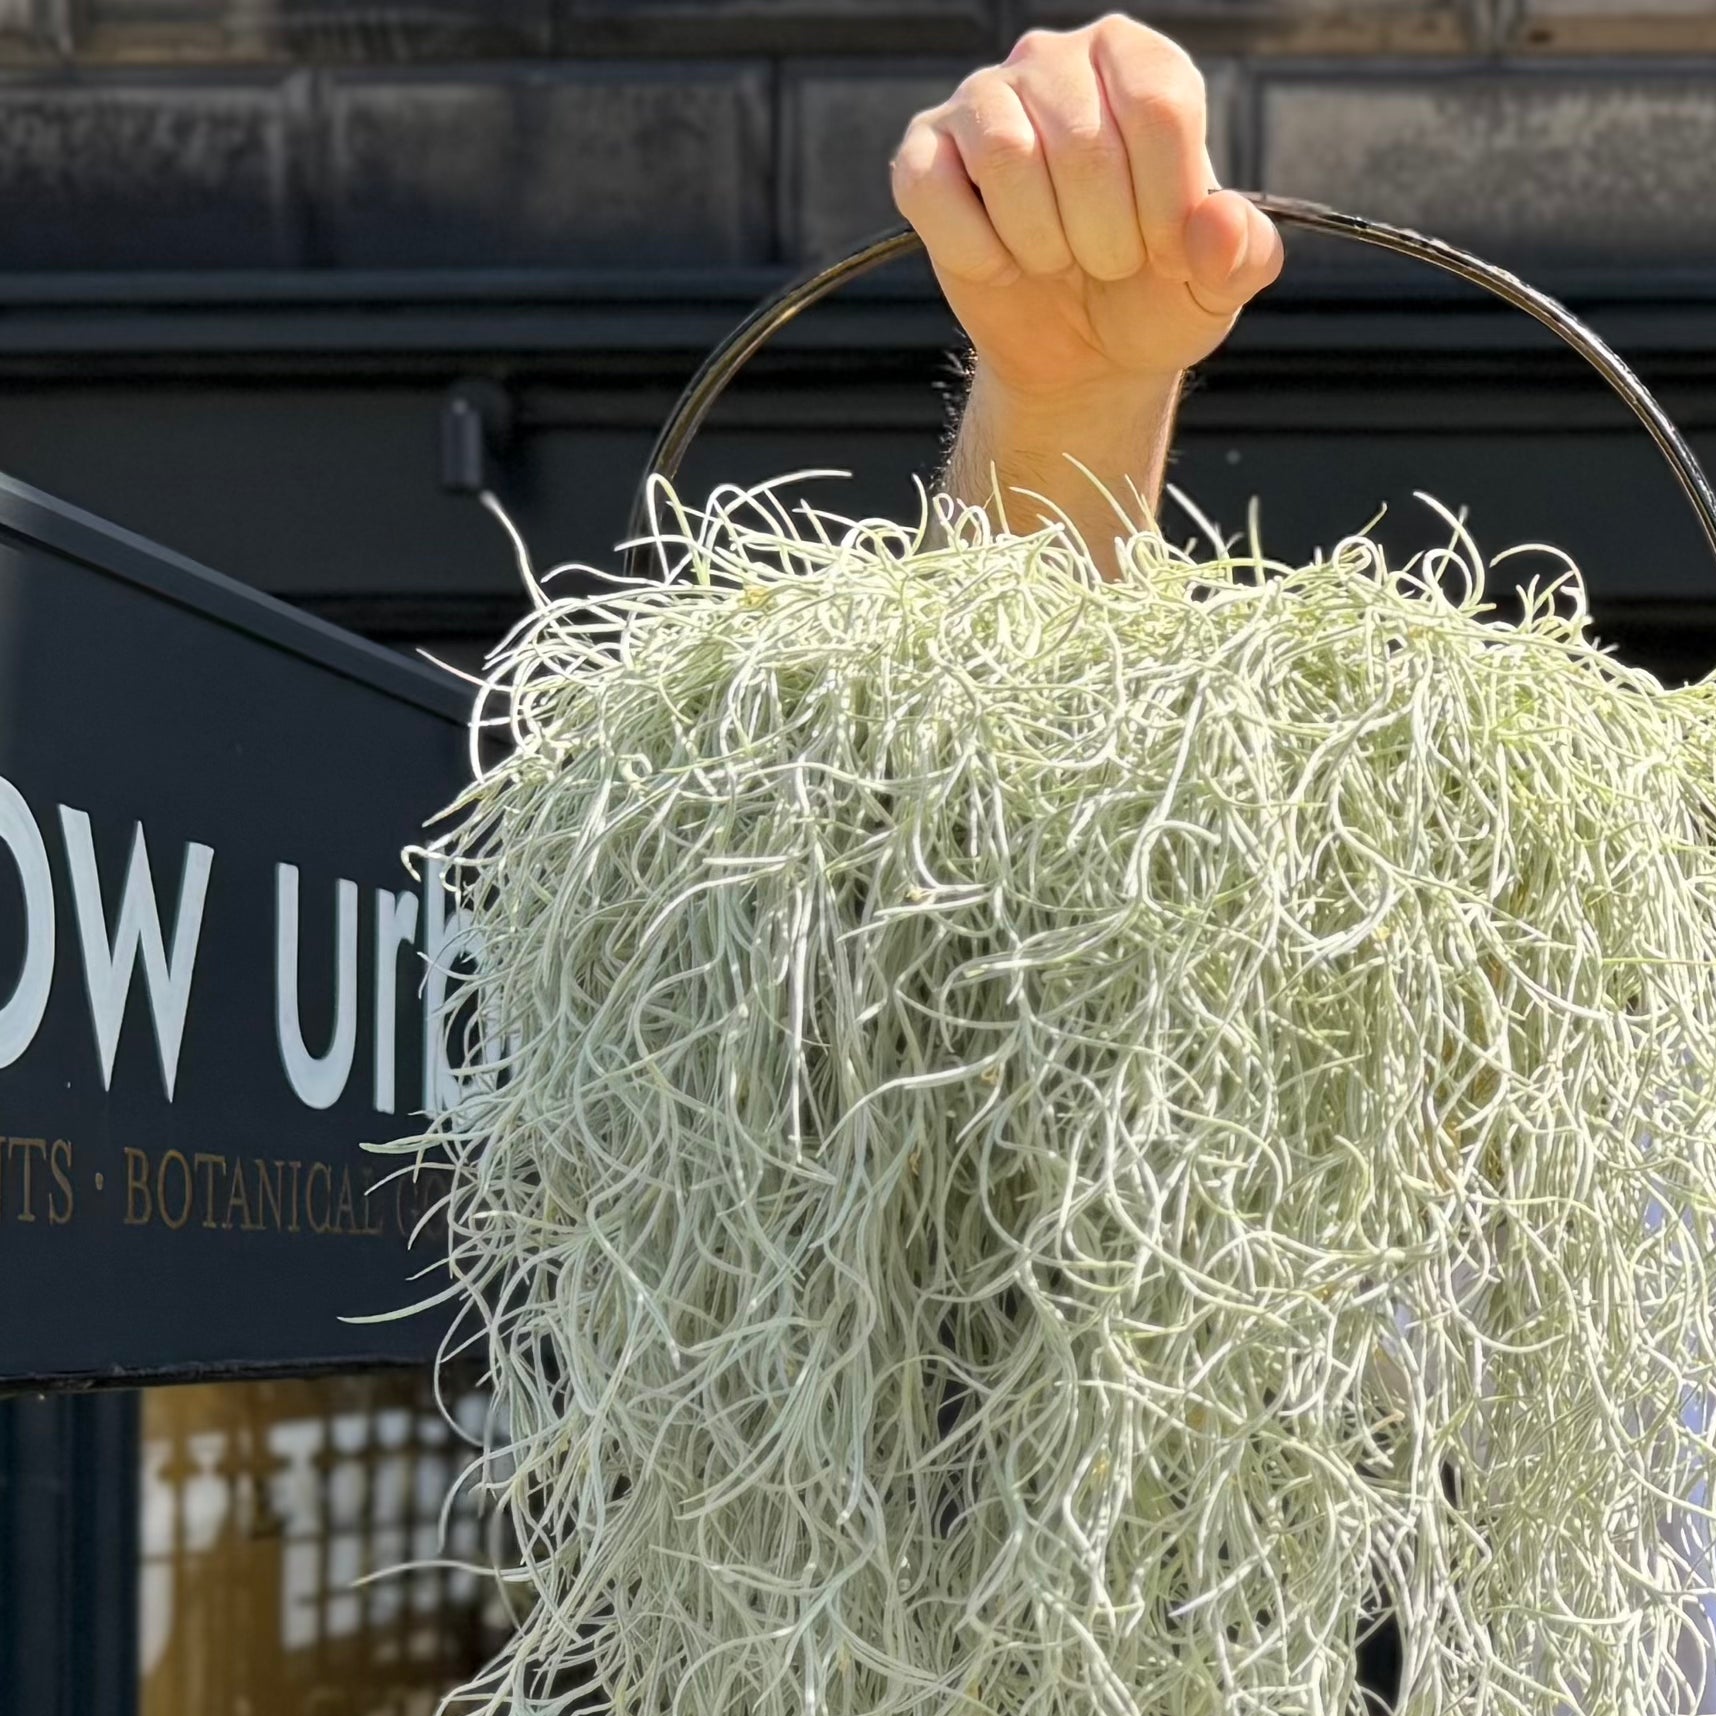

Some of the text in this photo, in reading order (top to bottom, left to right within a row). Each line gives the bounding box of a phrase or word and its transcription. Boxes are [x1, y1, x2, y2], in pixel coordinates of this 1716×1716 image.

[274, 838, 506, 1124] urb
[0, 1134, 74, 1226] TS
[123, 1145, 384, 1236] BOTANICAL
